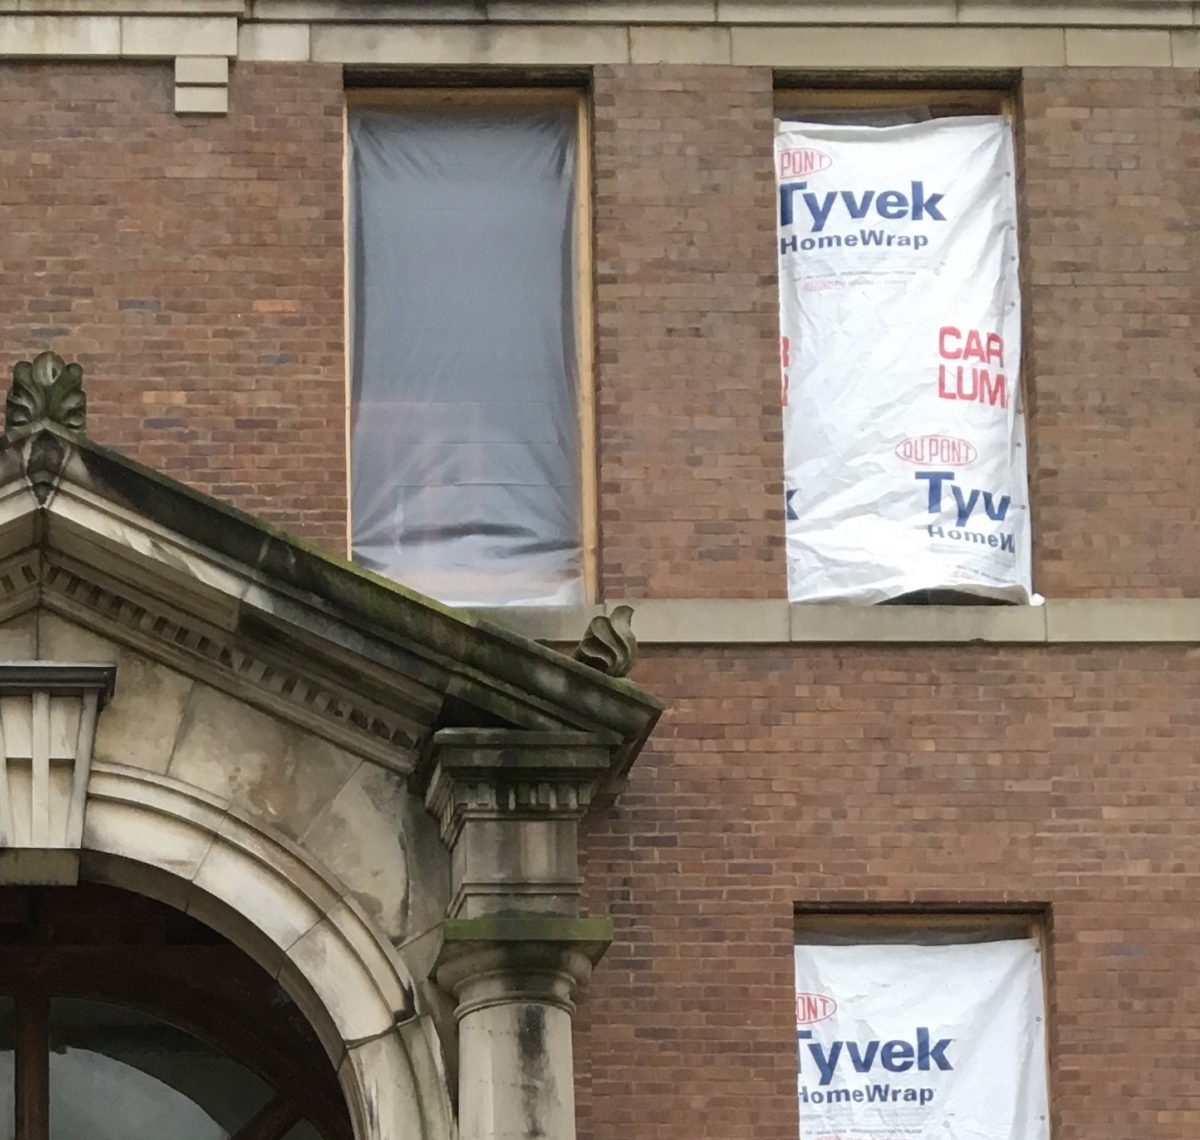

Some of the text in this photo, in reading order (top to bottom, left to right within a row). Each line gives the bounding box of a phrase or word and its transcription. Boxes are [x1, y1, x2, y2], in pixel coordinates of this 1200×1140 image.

[780, 180, 948, 232] Tyvek
[780, 229, 929, 255] HomeWrap
[938, 326, 1004, 368] CAR
[914, 471, 1011, 528] Tyv
